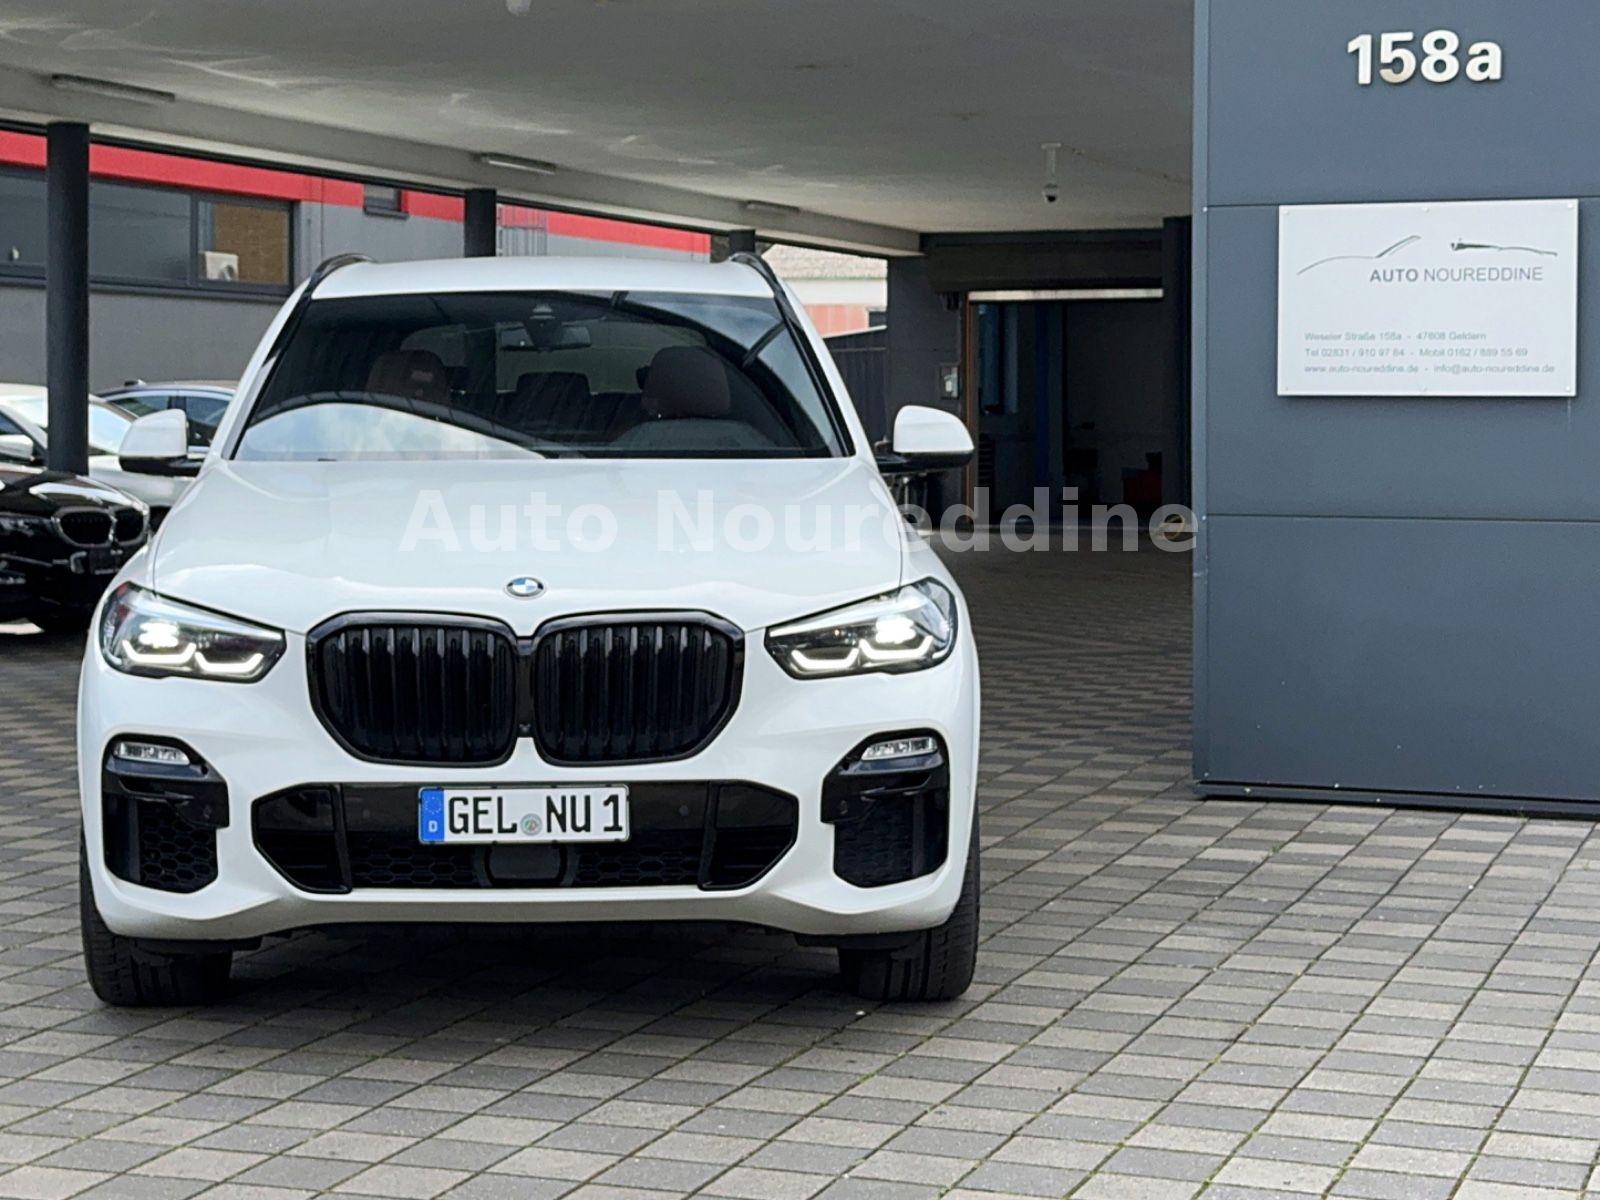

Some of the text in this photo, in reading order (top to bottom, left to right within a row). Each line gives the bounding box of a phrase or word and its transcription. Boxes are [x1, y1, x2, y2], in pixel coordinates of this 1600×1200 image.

[1347, 29, 1502, 85] 158a
[1370, 267, 1543, 282] AUTO NOUREDDINE
[1344, 331, 1376, 341] Straße
[1379, 331, 1402, 341] 158a
[449, 794, 623, 834] GEL NU 1
